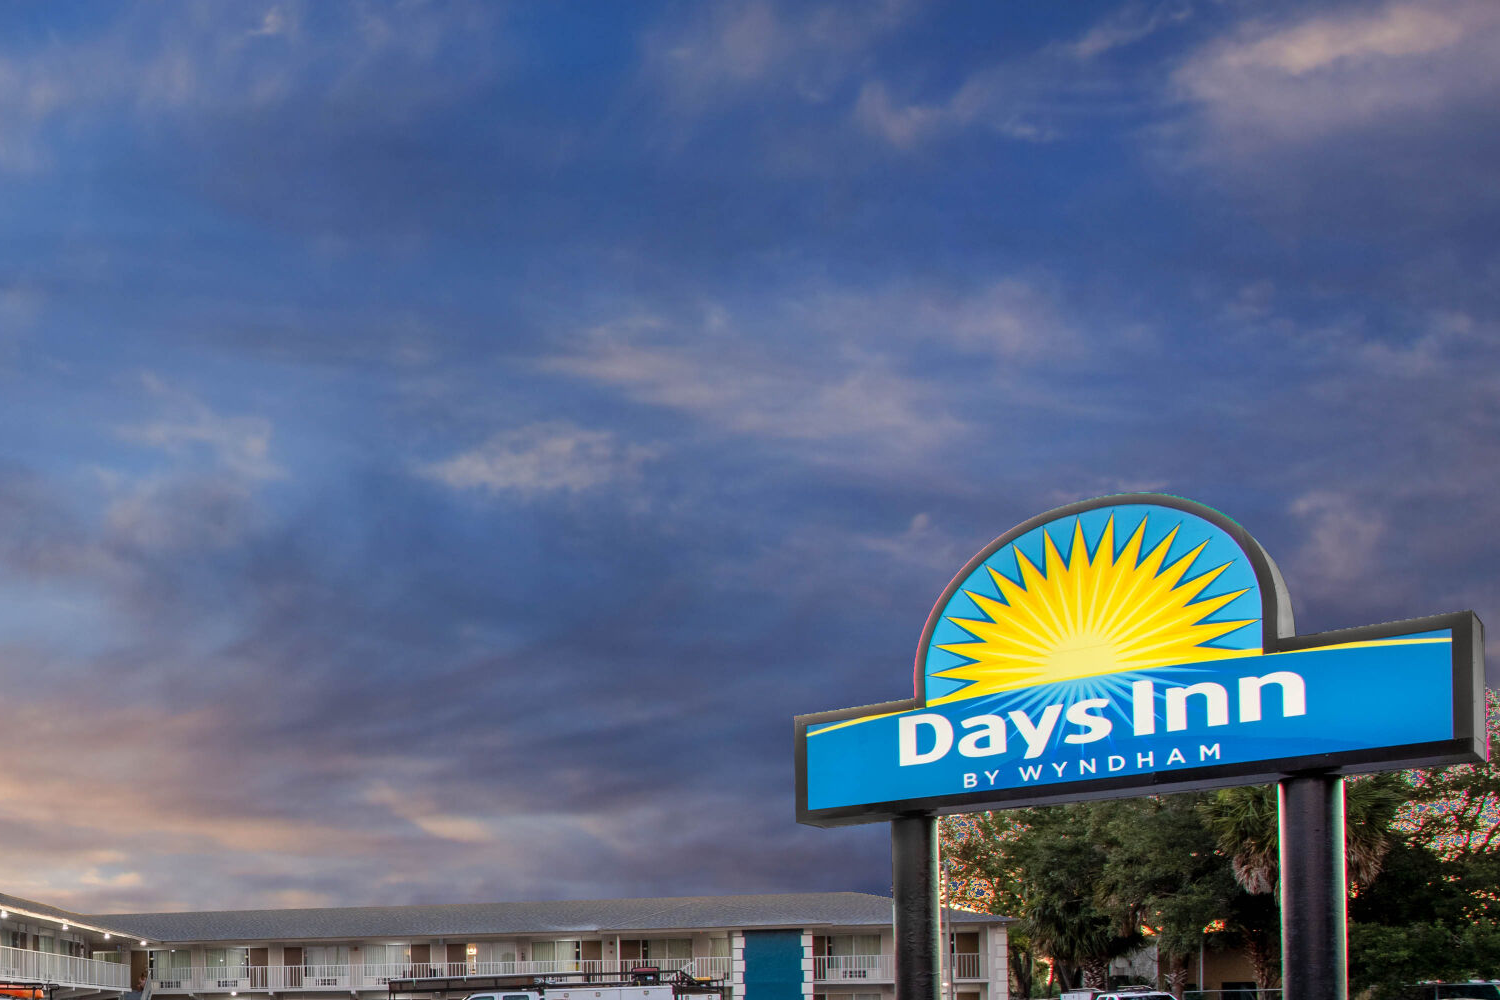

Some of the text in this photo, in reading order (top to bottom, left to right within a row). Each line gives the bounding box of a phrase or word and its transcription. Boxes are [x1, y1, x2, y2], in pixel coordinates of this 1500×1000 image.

[898, 671, 1307, 767] Days Inn
[963, 743, 1221, 789] BY WYNDHAM
